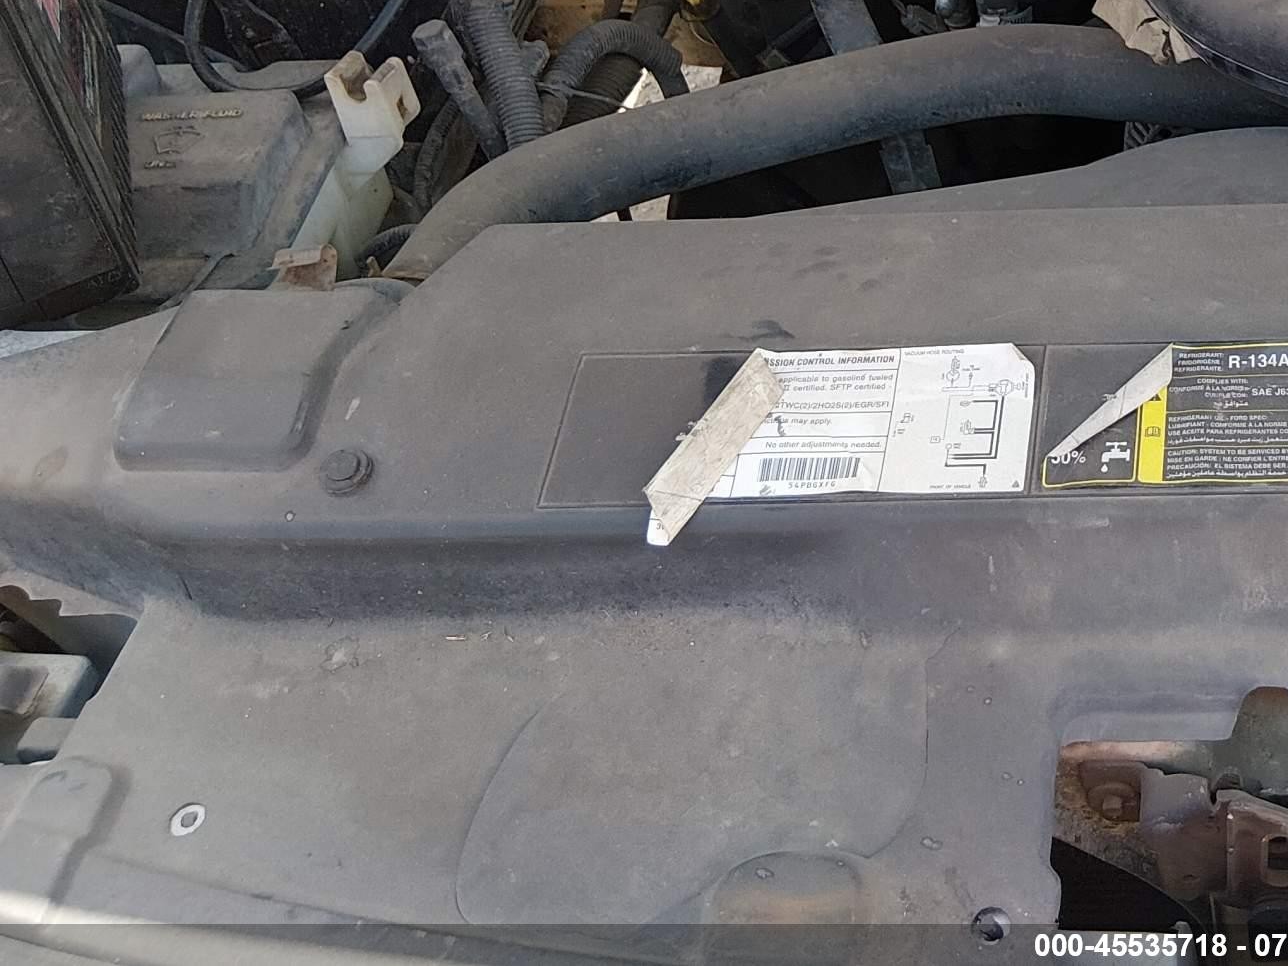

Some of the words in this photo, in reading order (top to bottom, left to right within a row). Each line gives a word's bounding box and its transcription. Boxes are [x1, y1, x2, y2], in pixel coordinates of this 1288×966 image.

[797, 357, 835, 366] CONTROL
[838, 355, 894, 365] INFORMATION
[821, 375, 830, 383] to
[868, 374, 894, 382] fueled
[854, 383, 886, 392] certified
[1251, 388, 1273, 397] SAE
[791, 418, 809, 426] may
[810, 417, 832, 427] apply.
[765, 441, 777, 449] No
